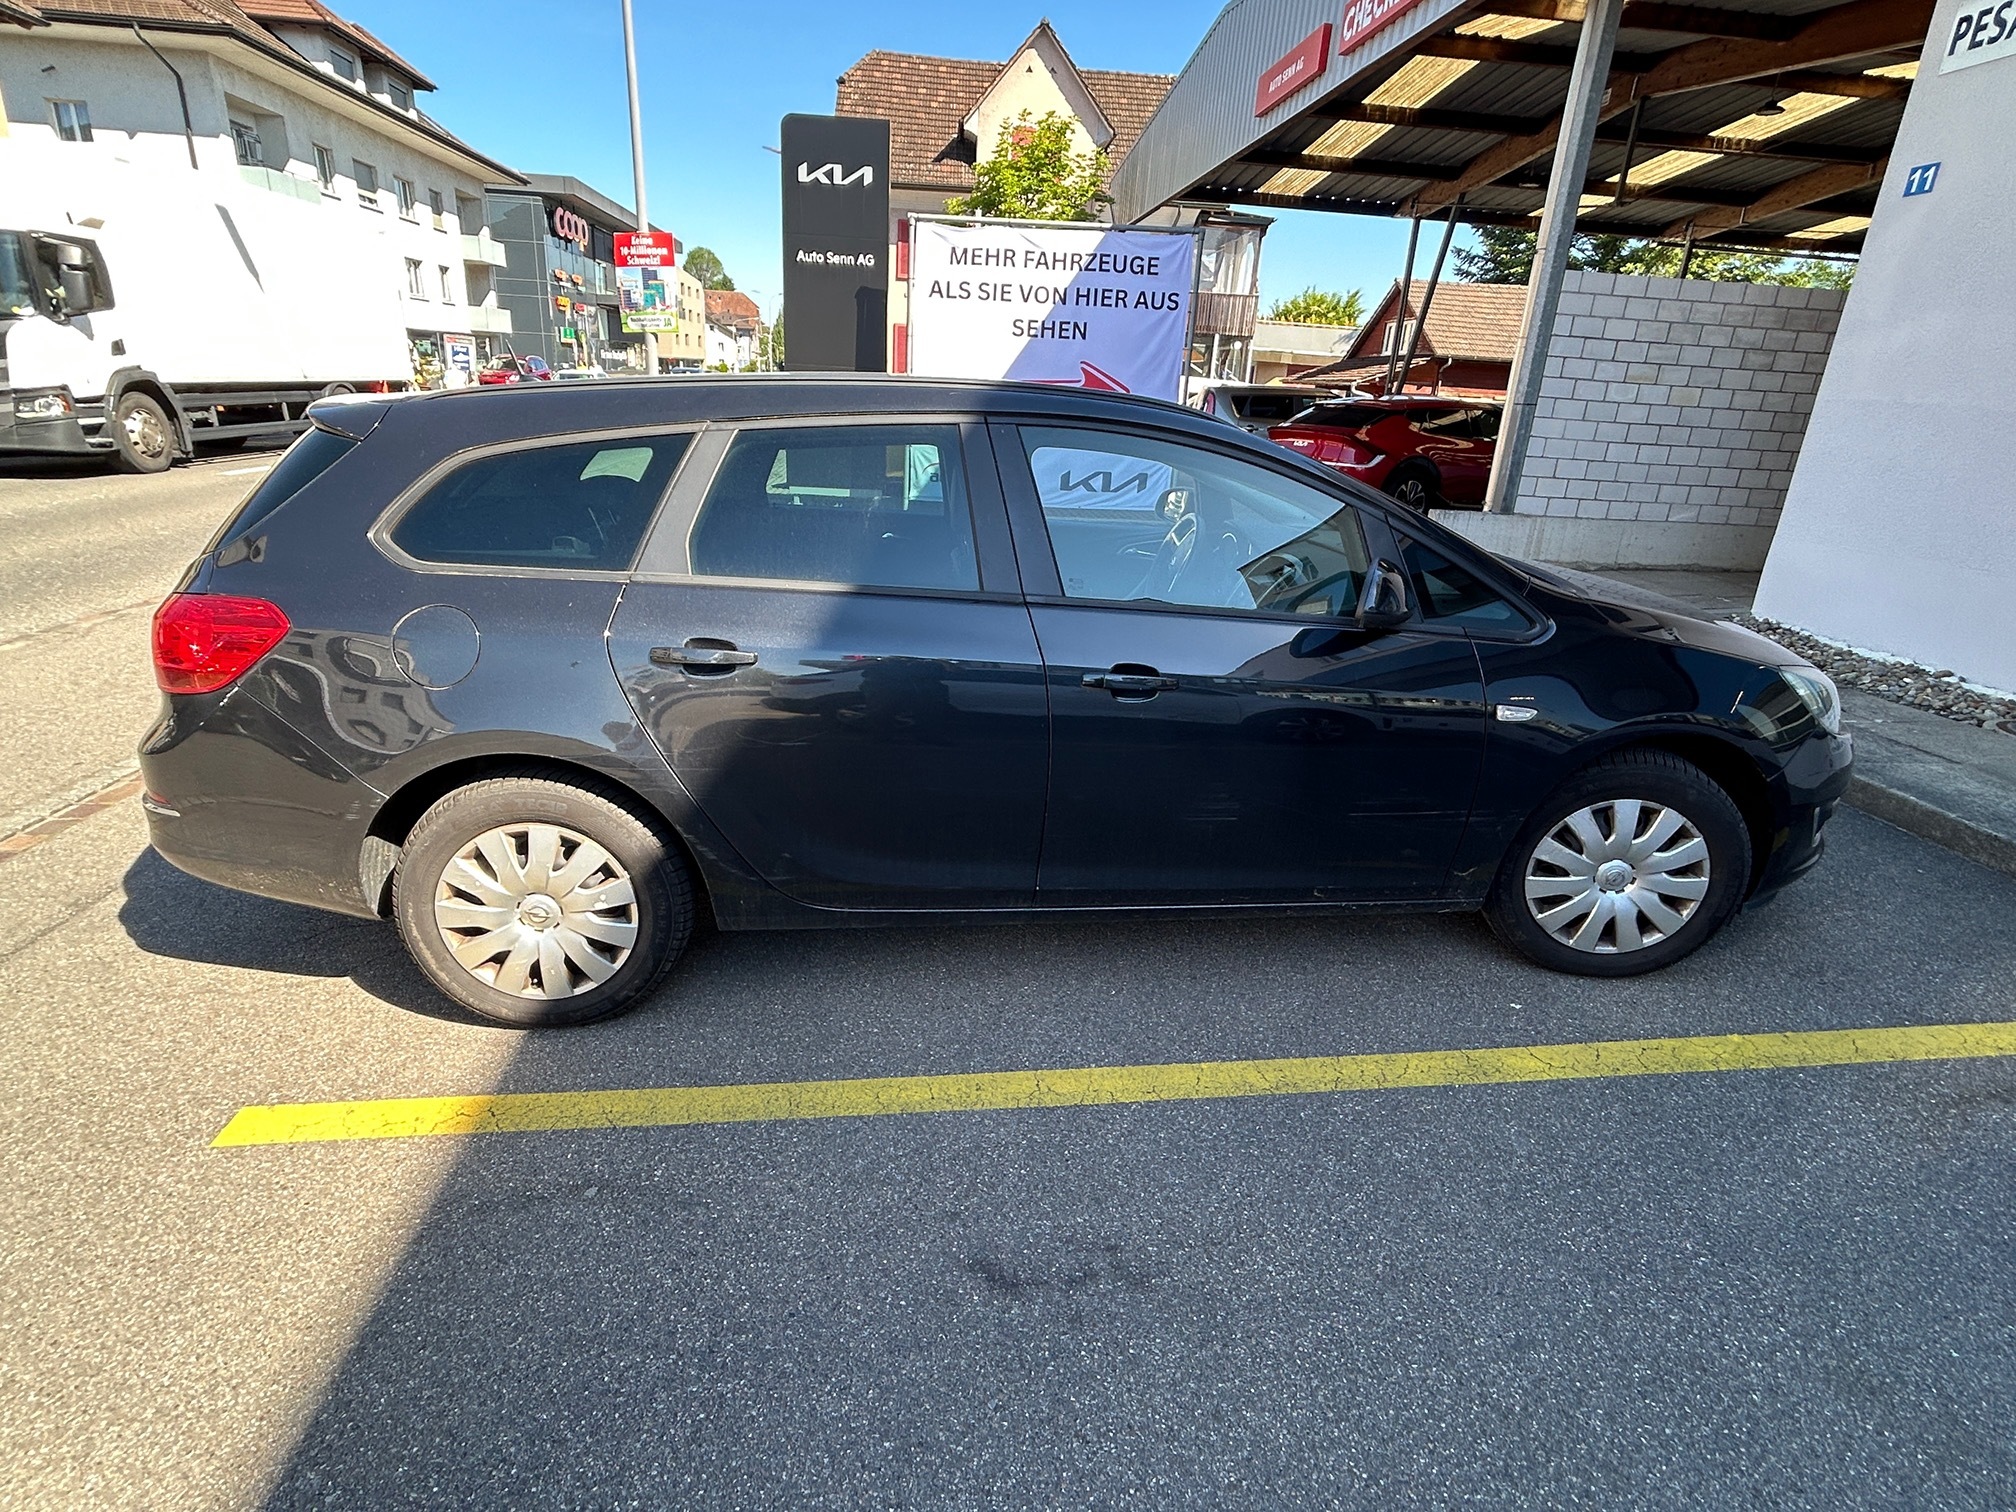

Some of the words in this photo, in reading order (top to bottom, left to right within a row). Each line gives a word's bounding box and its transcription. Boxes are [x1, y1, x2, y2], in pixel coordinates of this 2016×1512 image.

[1343, 0, 1400, 41] CHEC
[1268, 73, 1282, 94] AUTO
[1282, 62, 1296, 83] SENN
[797, 161, 874, 187] KIA
[1909, 166, 1937, 194] 11
[620, 245, 668, 256] 10-Millionen
[631, 235, 653, 245] Keine
[796, 249, 825, 262] Auto
[827, 251, 855, 265] Senn
[856, 253, 875, 266] AG
[949, 246, 1016, 268] MEHR
[1023, 250, 1160, 276] FAHRZEUGE
[928, 279, 971, 300] ALS
[978, 282, 1012, 302] SIE
[1019, 284, 1068, 306] VON
[1075, 287, 1128, 309] HIER
[1133, 290, 1180, 312] AUS
[1012, 318, 1088, 341] SEHEN
[1060, 469, 1149, 493] KIA
